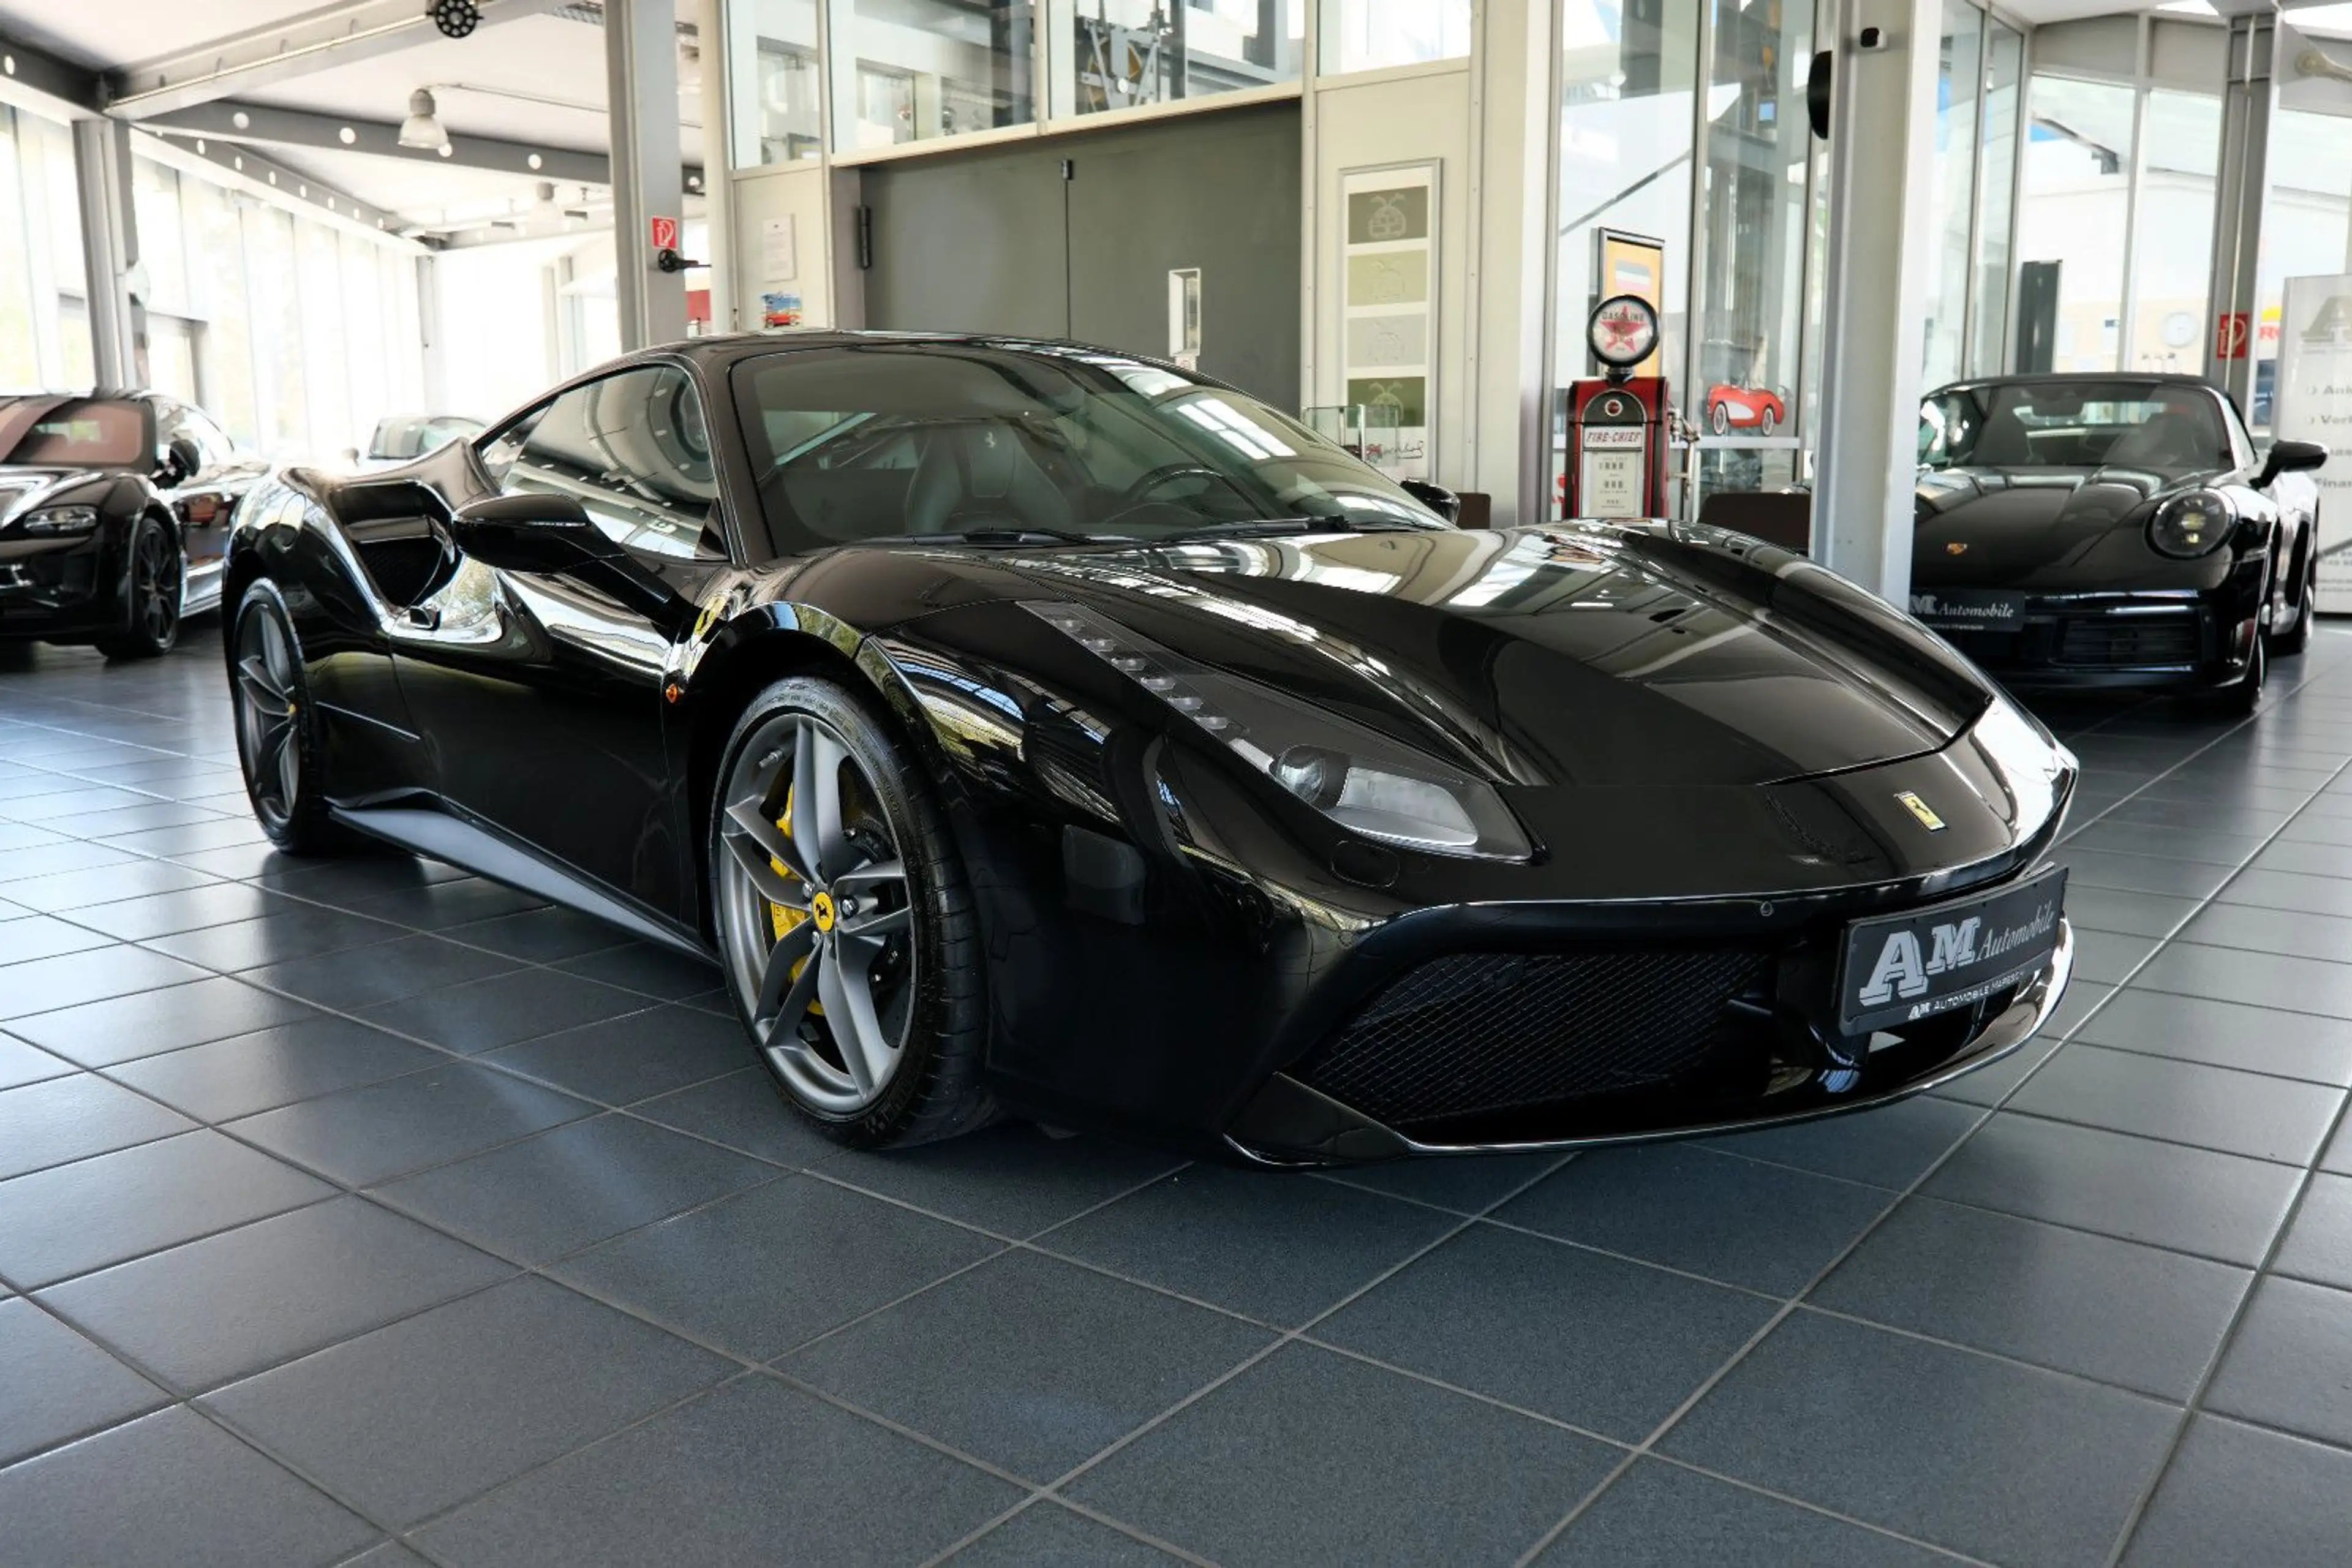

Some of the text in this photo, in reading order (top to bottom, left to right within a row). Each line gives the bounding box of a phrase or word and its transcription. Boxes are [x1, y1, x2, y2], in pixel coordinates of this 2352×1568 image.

[1586, 431, 1642, 442] FIRE-CHIEF
[1939, 602, 2015, 619] Automobile
[1976, 900, 2055, 962] Automobile
[1934, 985, 1989, 1010] AUTOMOBILE
